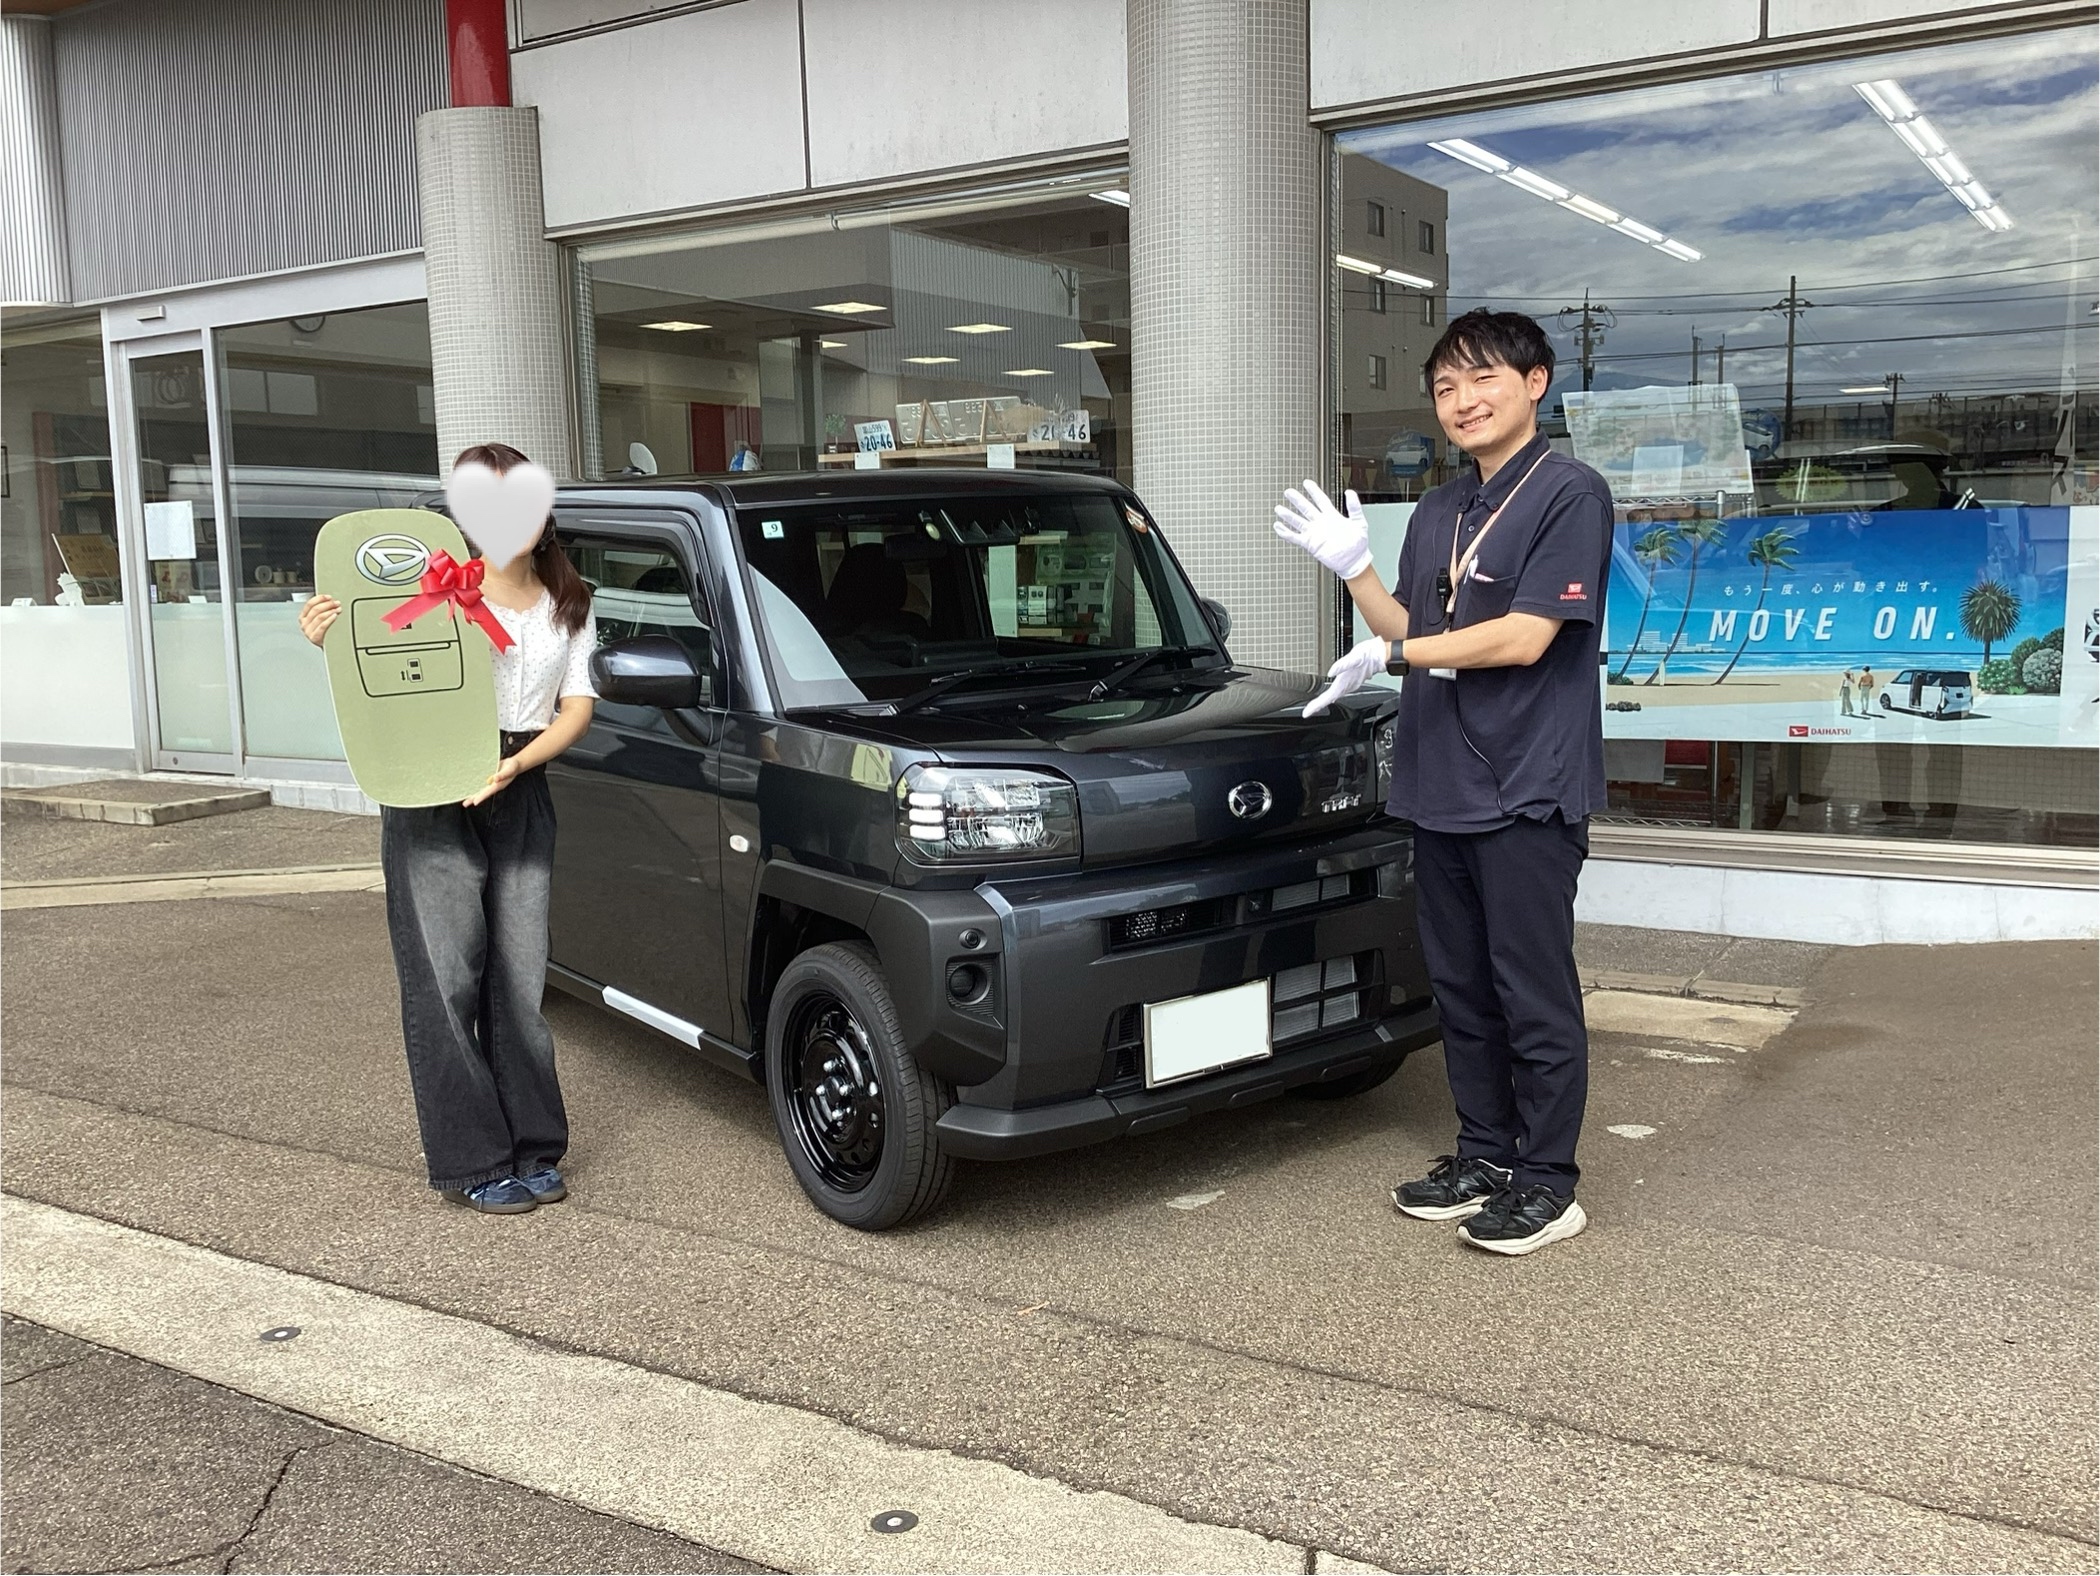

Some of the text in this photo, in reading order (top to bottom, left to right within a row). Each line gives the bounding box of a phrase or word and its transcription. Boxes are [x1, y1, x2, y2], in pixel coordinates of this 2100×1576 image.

[771, 523, 778, 533] 9
[1723, 581, 1939, 597] もう一度、心が動き出す。
[1708, 605, 1957, 643] MOVE ON.
[1811, 728, 1852, 736] DAIHATSU
